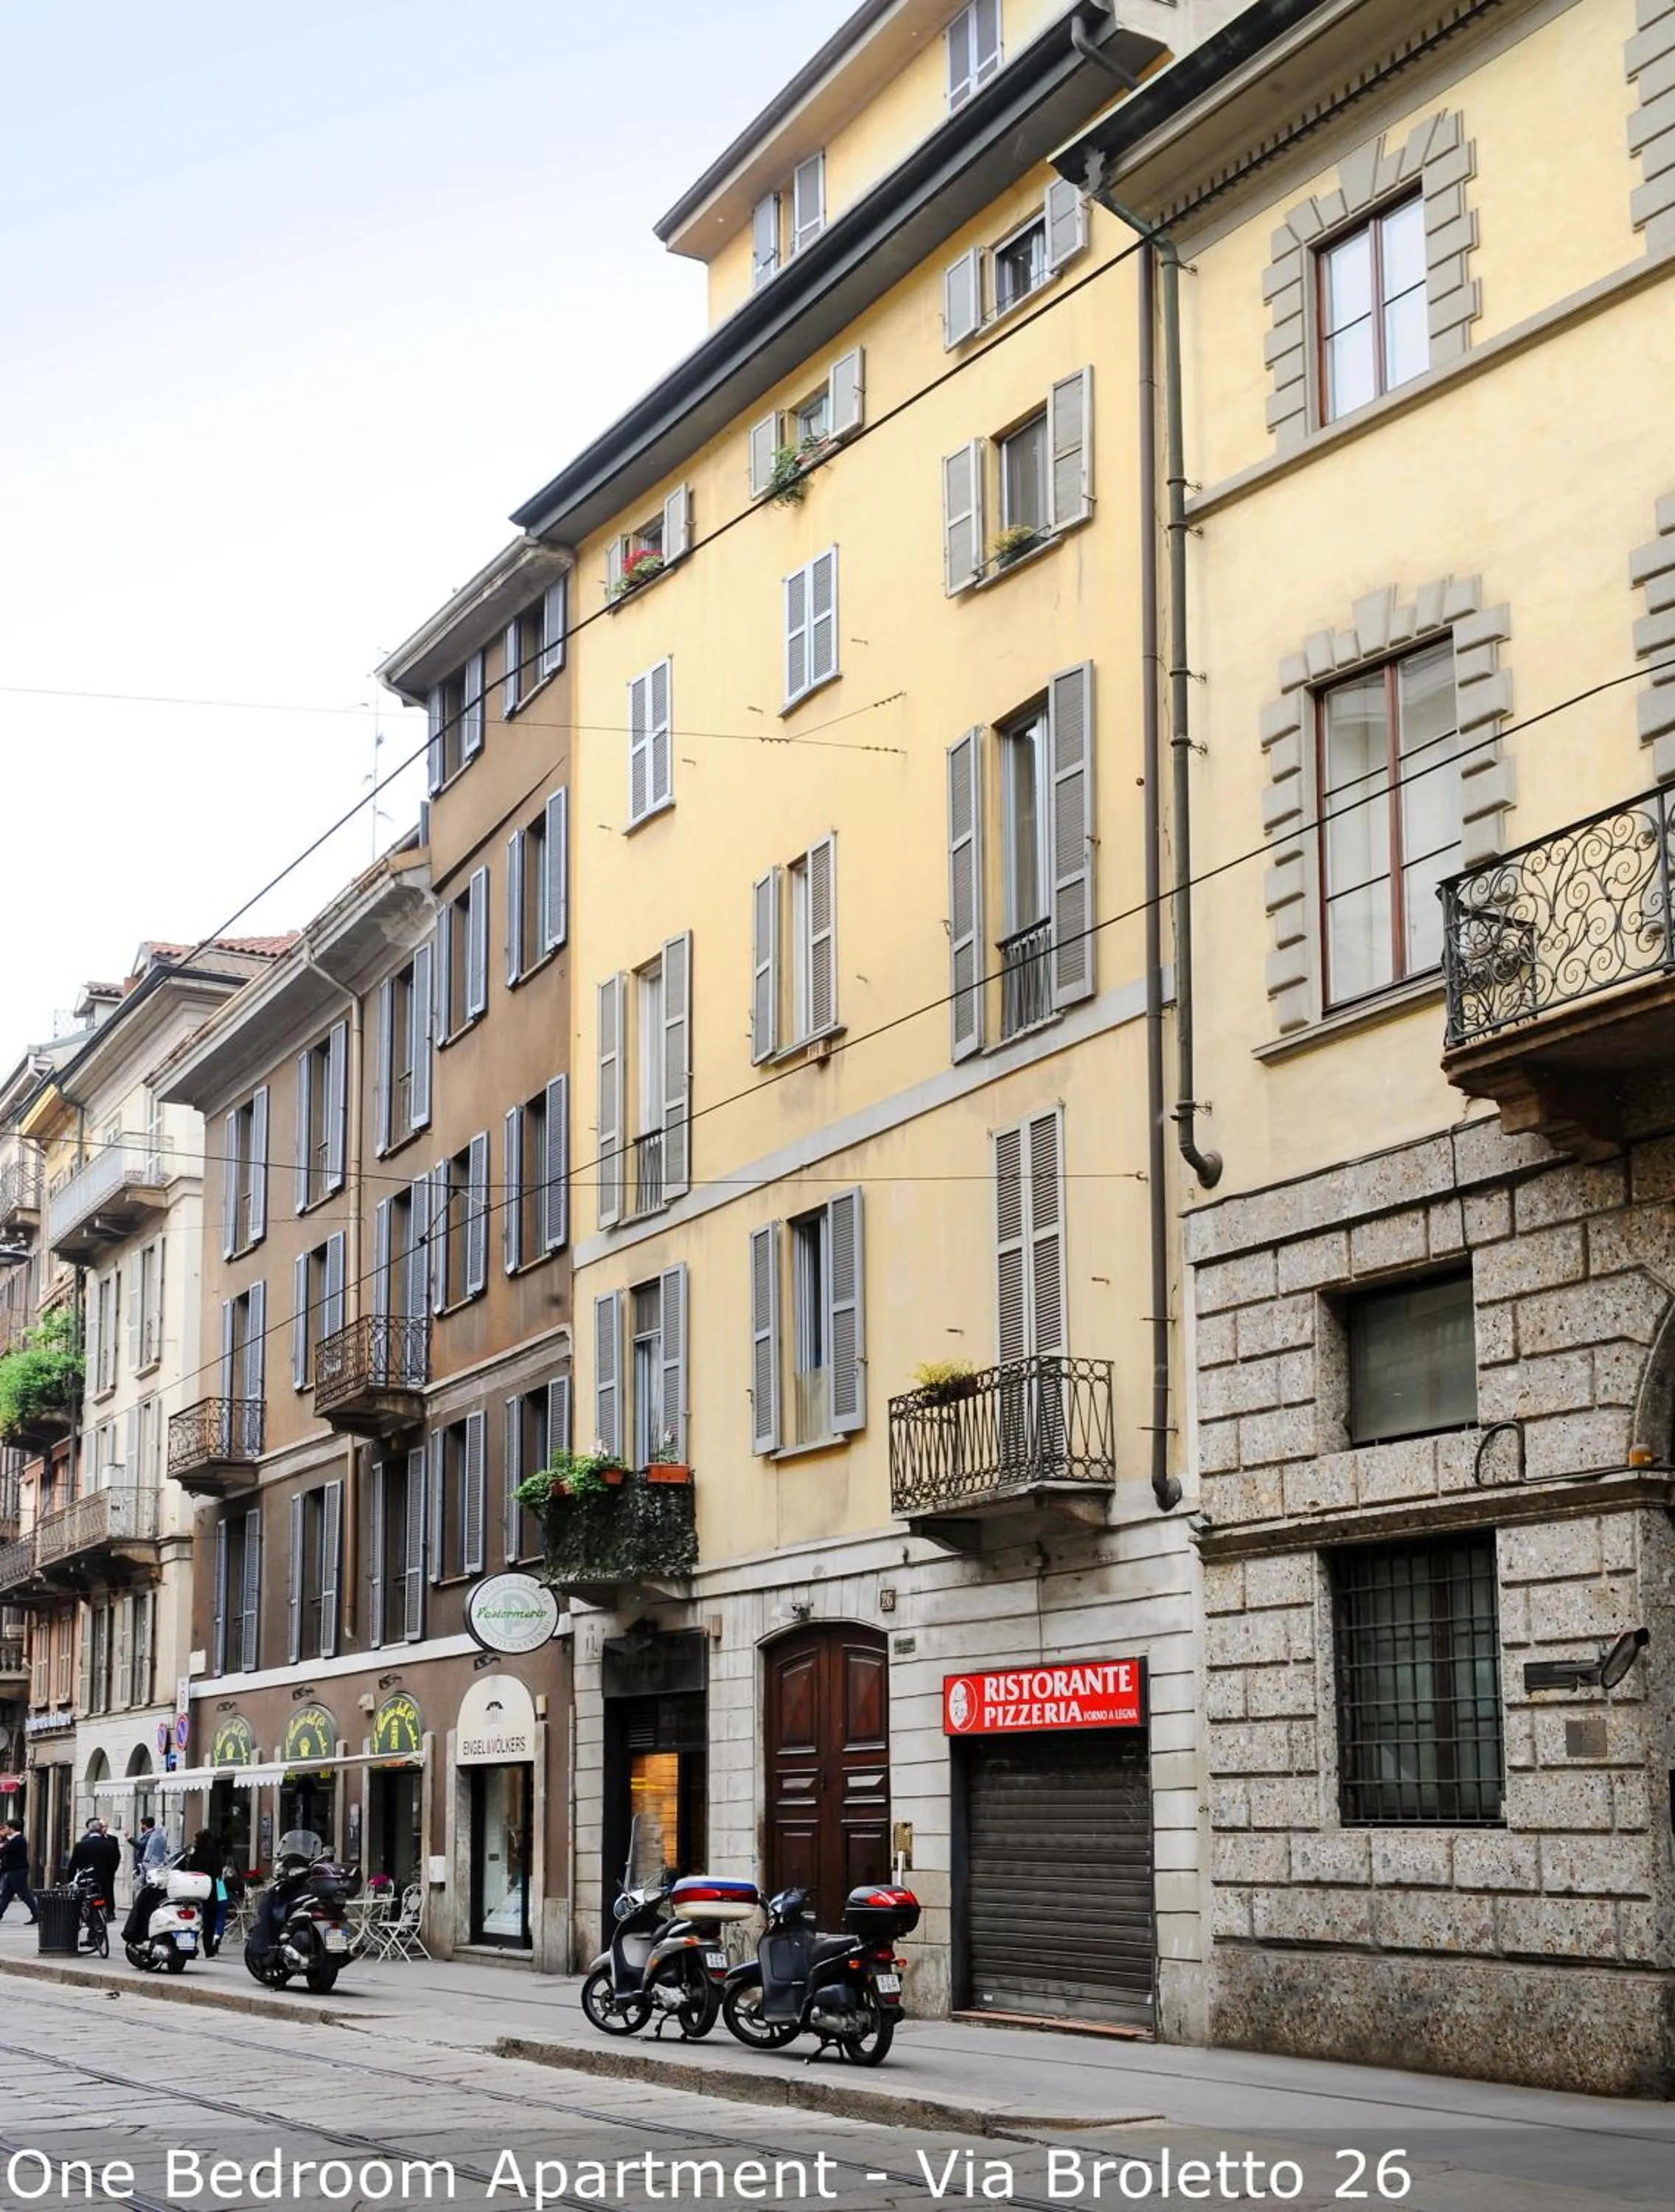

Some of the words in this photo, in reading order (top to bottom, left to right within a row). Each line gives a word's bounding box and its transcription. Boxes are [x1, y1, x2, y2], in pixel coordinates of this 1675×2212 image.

[983, 1664, 1133, 1703] RISTORANTE
[983, 1700, 1084, 1728] PIZZERIA
[1115, 1708, 1138, 1720] LEGNA
